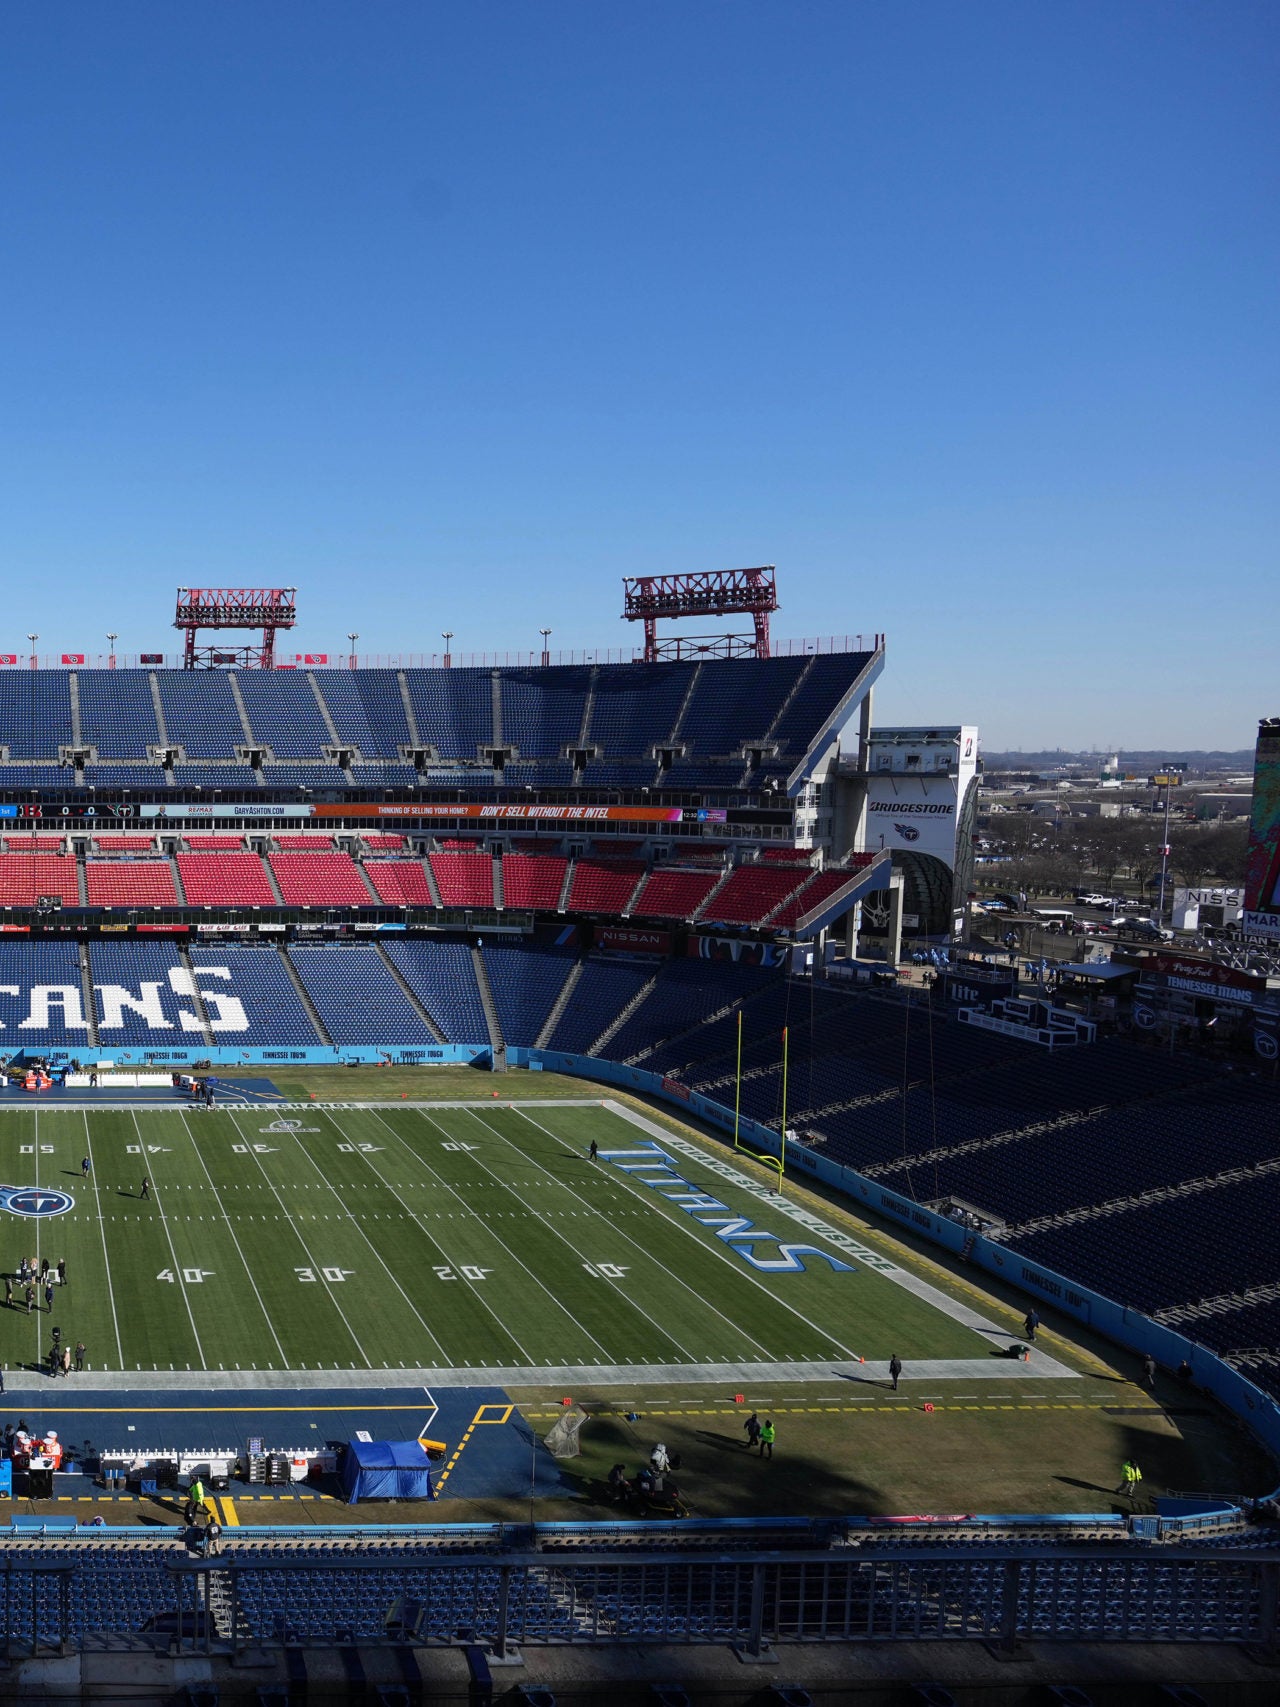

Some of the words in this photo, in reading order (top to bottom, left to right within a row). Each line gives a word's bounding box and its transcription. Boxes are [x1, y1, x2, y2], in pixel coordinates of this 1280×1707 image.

[62, 806, 70, 815] 0
[87, 806, 95, 815] 0
[449, 807, 468, 815] HOME?
[480, 806, 506, 816] DON'T
[506, 807, 525, 817] SELL
[526, 807, 566, 817] WITHOUT
[566, 807, 584, 817] THE
[584, 807, 609, 818] INTEL
[869, 801, 955, 814] BRIDGESTONE
[1247, 913, 1280, 927] MAR
[603, 931, 660, 944] NISSAN
[1246, 926, 1280, 938] Petcare
[951, 983, 979, 1000] Lite
[1167, 976, 1217, 994] TENNESSEE
[1218, 985, 1253, 1001] TITANS
[143, 1051, 170, 1060] TENNESSEE
[171, 1051, 188, 1060] TOUGH
[262, 1051, 289, 1059] TENNESSEE
[289, 1051, 307, 1059] TOUGH
[427, 1050, 444, 1058] TOUGH
[19, 1145, 55, 1154] 50
[126, 1145, 164, 1154] 40
[231, 1144, 270, 1154] 30
[336, 1143, 377, 1153] 20
[585, 1140, 859, 1273] TITANS
[670, 1140, 740, 1178] ADVANCE
[802, 1218, 898, 1272] JUSTICE
[156, 1268, 205, 1283] 40
[293, 1267, 347, 1282] 30
[432, 1266, 487, 1281] 20
[582, 1263, 626, 1278] 10
